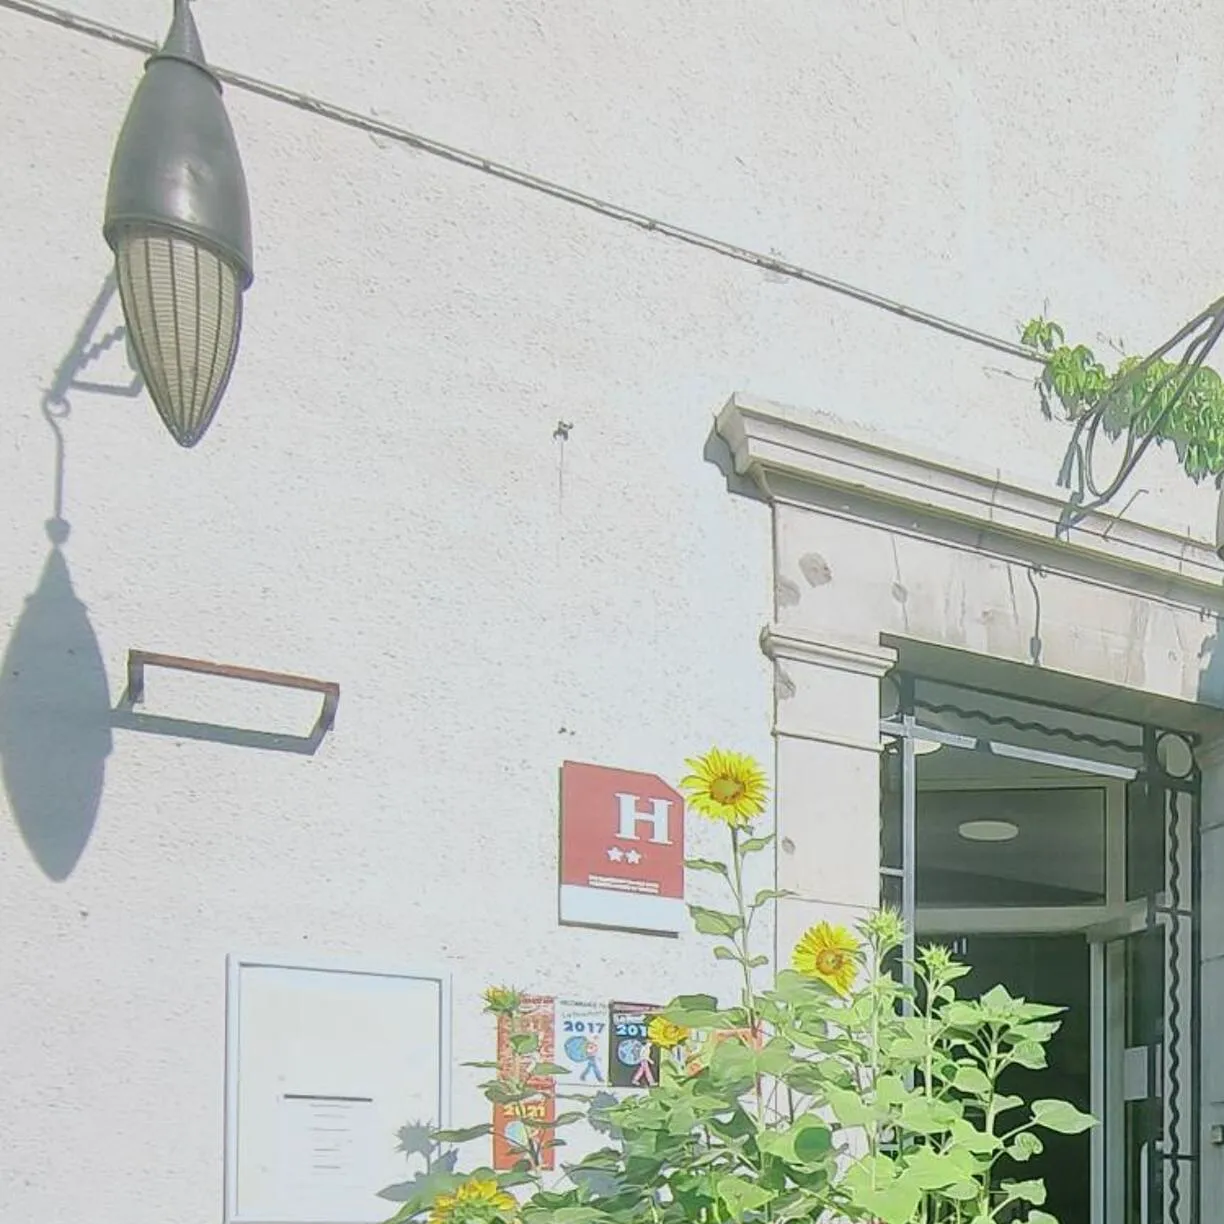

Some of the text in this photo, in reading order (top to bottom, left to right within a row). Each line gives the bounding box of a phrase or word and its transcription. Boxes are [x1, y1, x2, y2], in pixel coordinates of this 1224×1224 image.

[614, 793, 673, 845] H
[563, 1020, 605, 1034] 2017
[615, 1024, 647, 1037] 201
